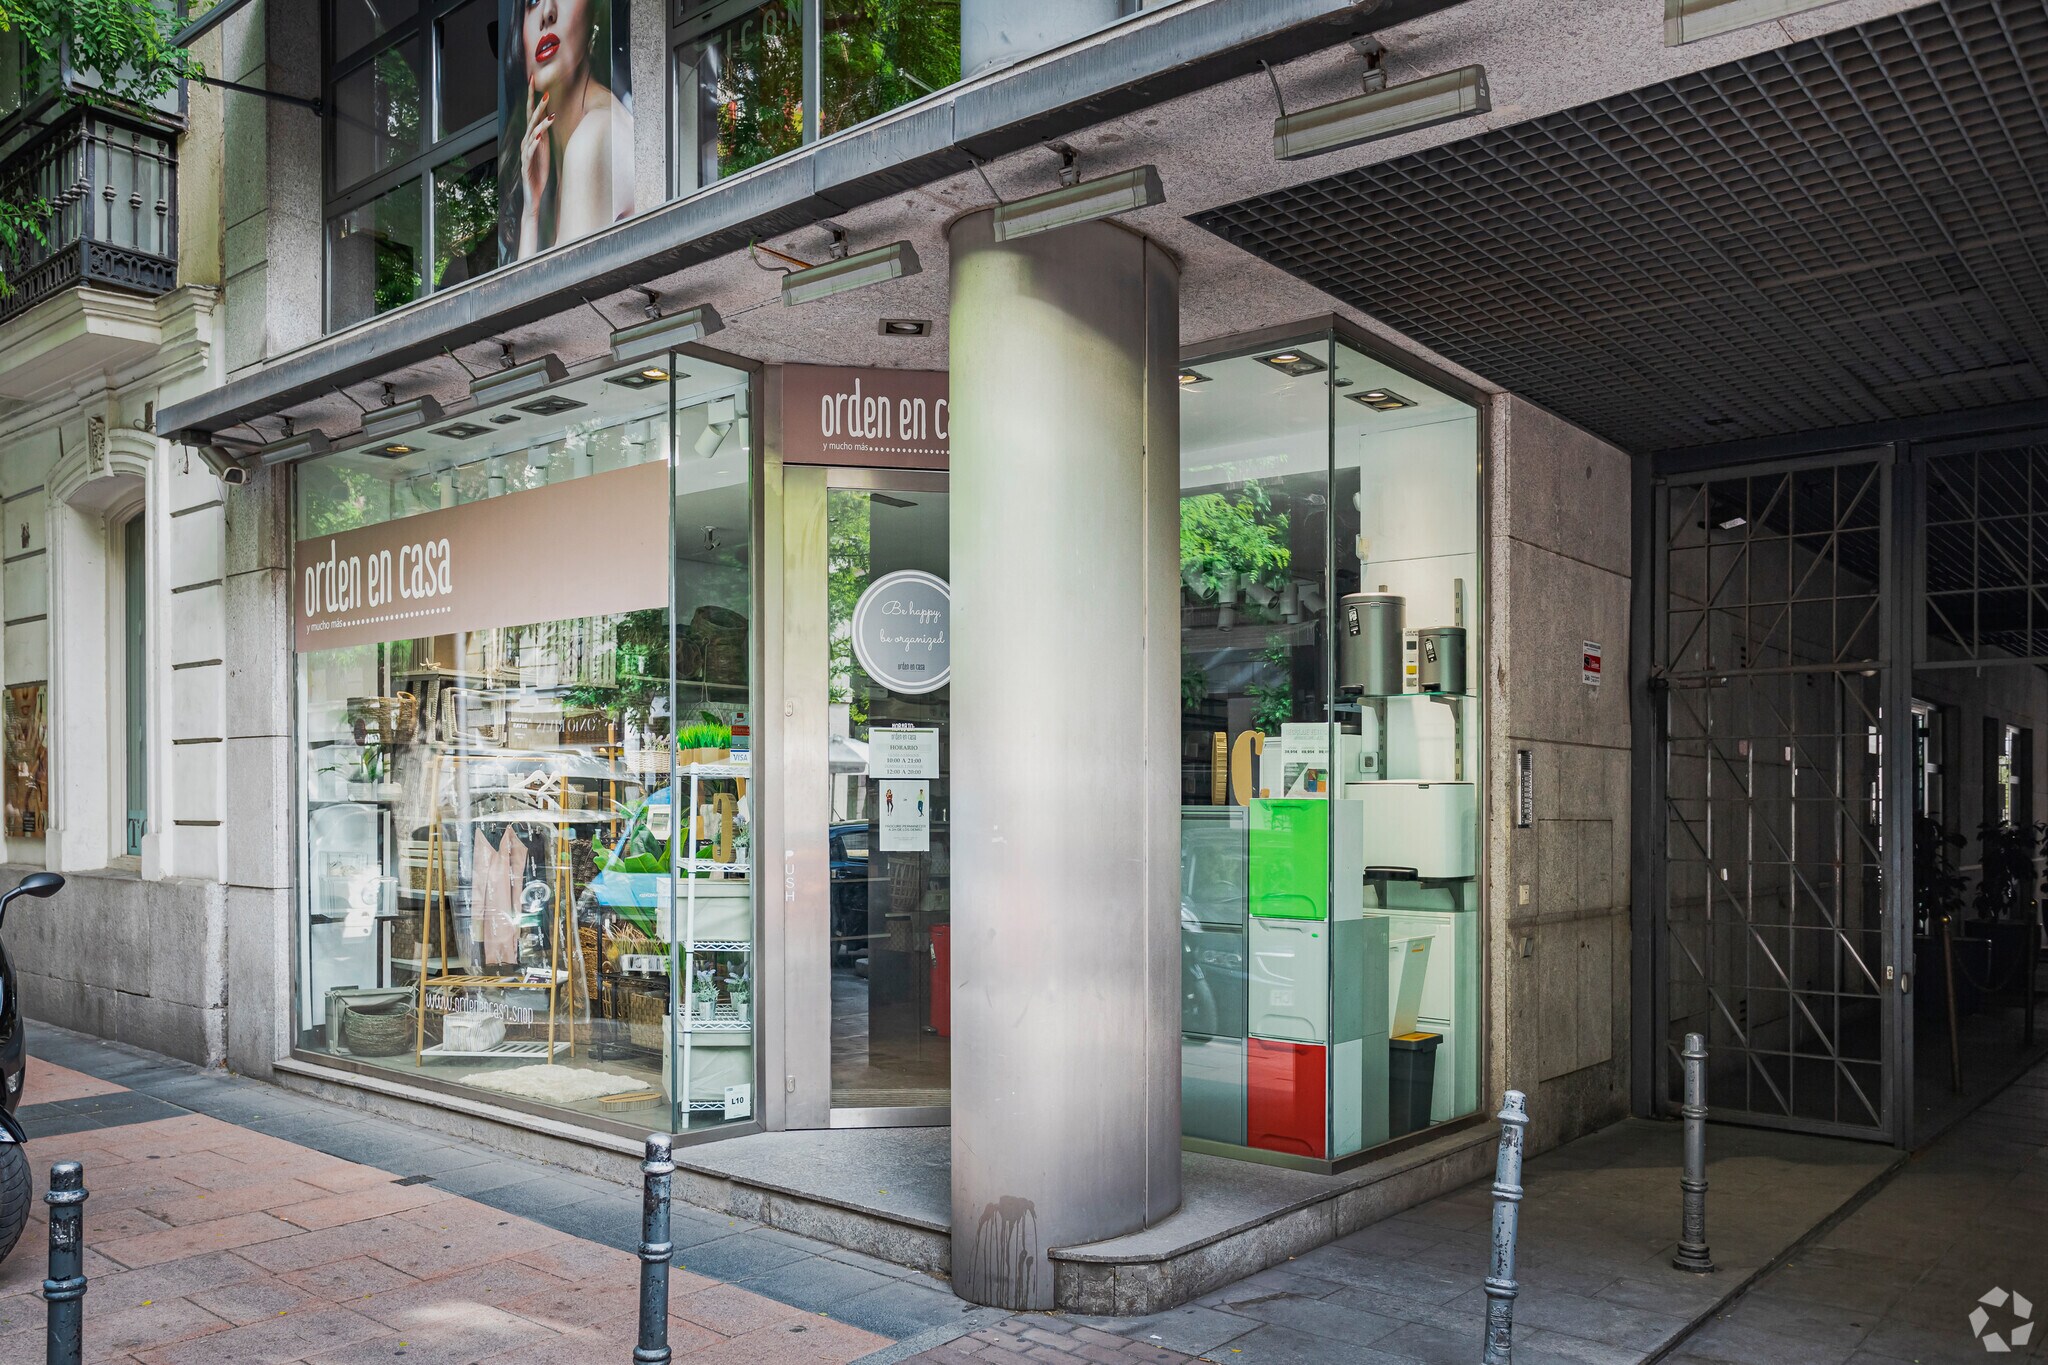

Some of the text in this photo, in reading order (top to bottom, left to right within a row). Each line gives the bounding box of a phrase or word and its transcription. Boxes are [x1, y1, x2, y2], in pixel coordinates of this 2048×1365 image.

[821, 378, 949, 440] orden en c
[822, 442, 869, 451] y mucho más
[305, 538, 453, 618] orden en casa
[881, 600, 942, 624] Be happy,
[306, 618, 343, 635] y mucho más
[880, 628, 945, 652] be organized
[784, 849, 795, 902] PUSH
[731, 1096, 744, 1105] L10
